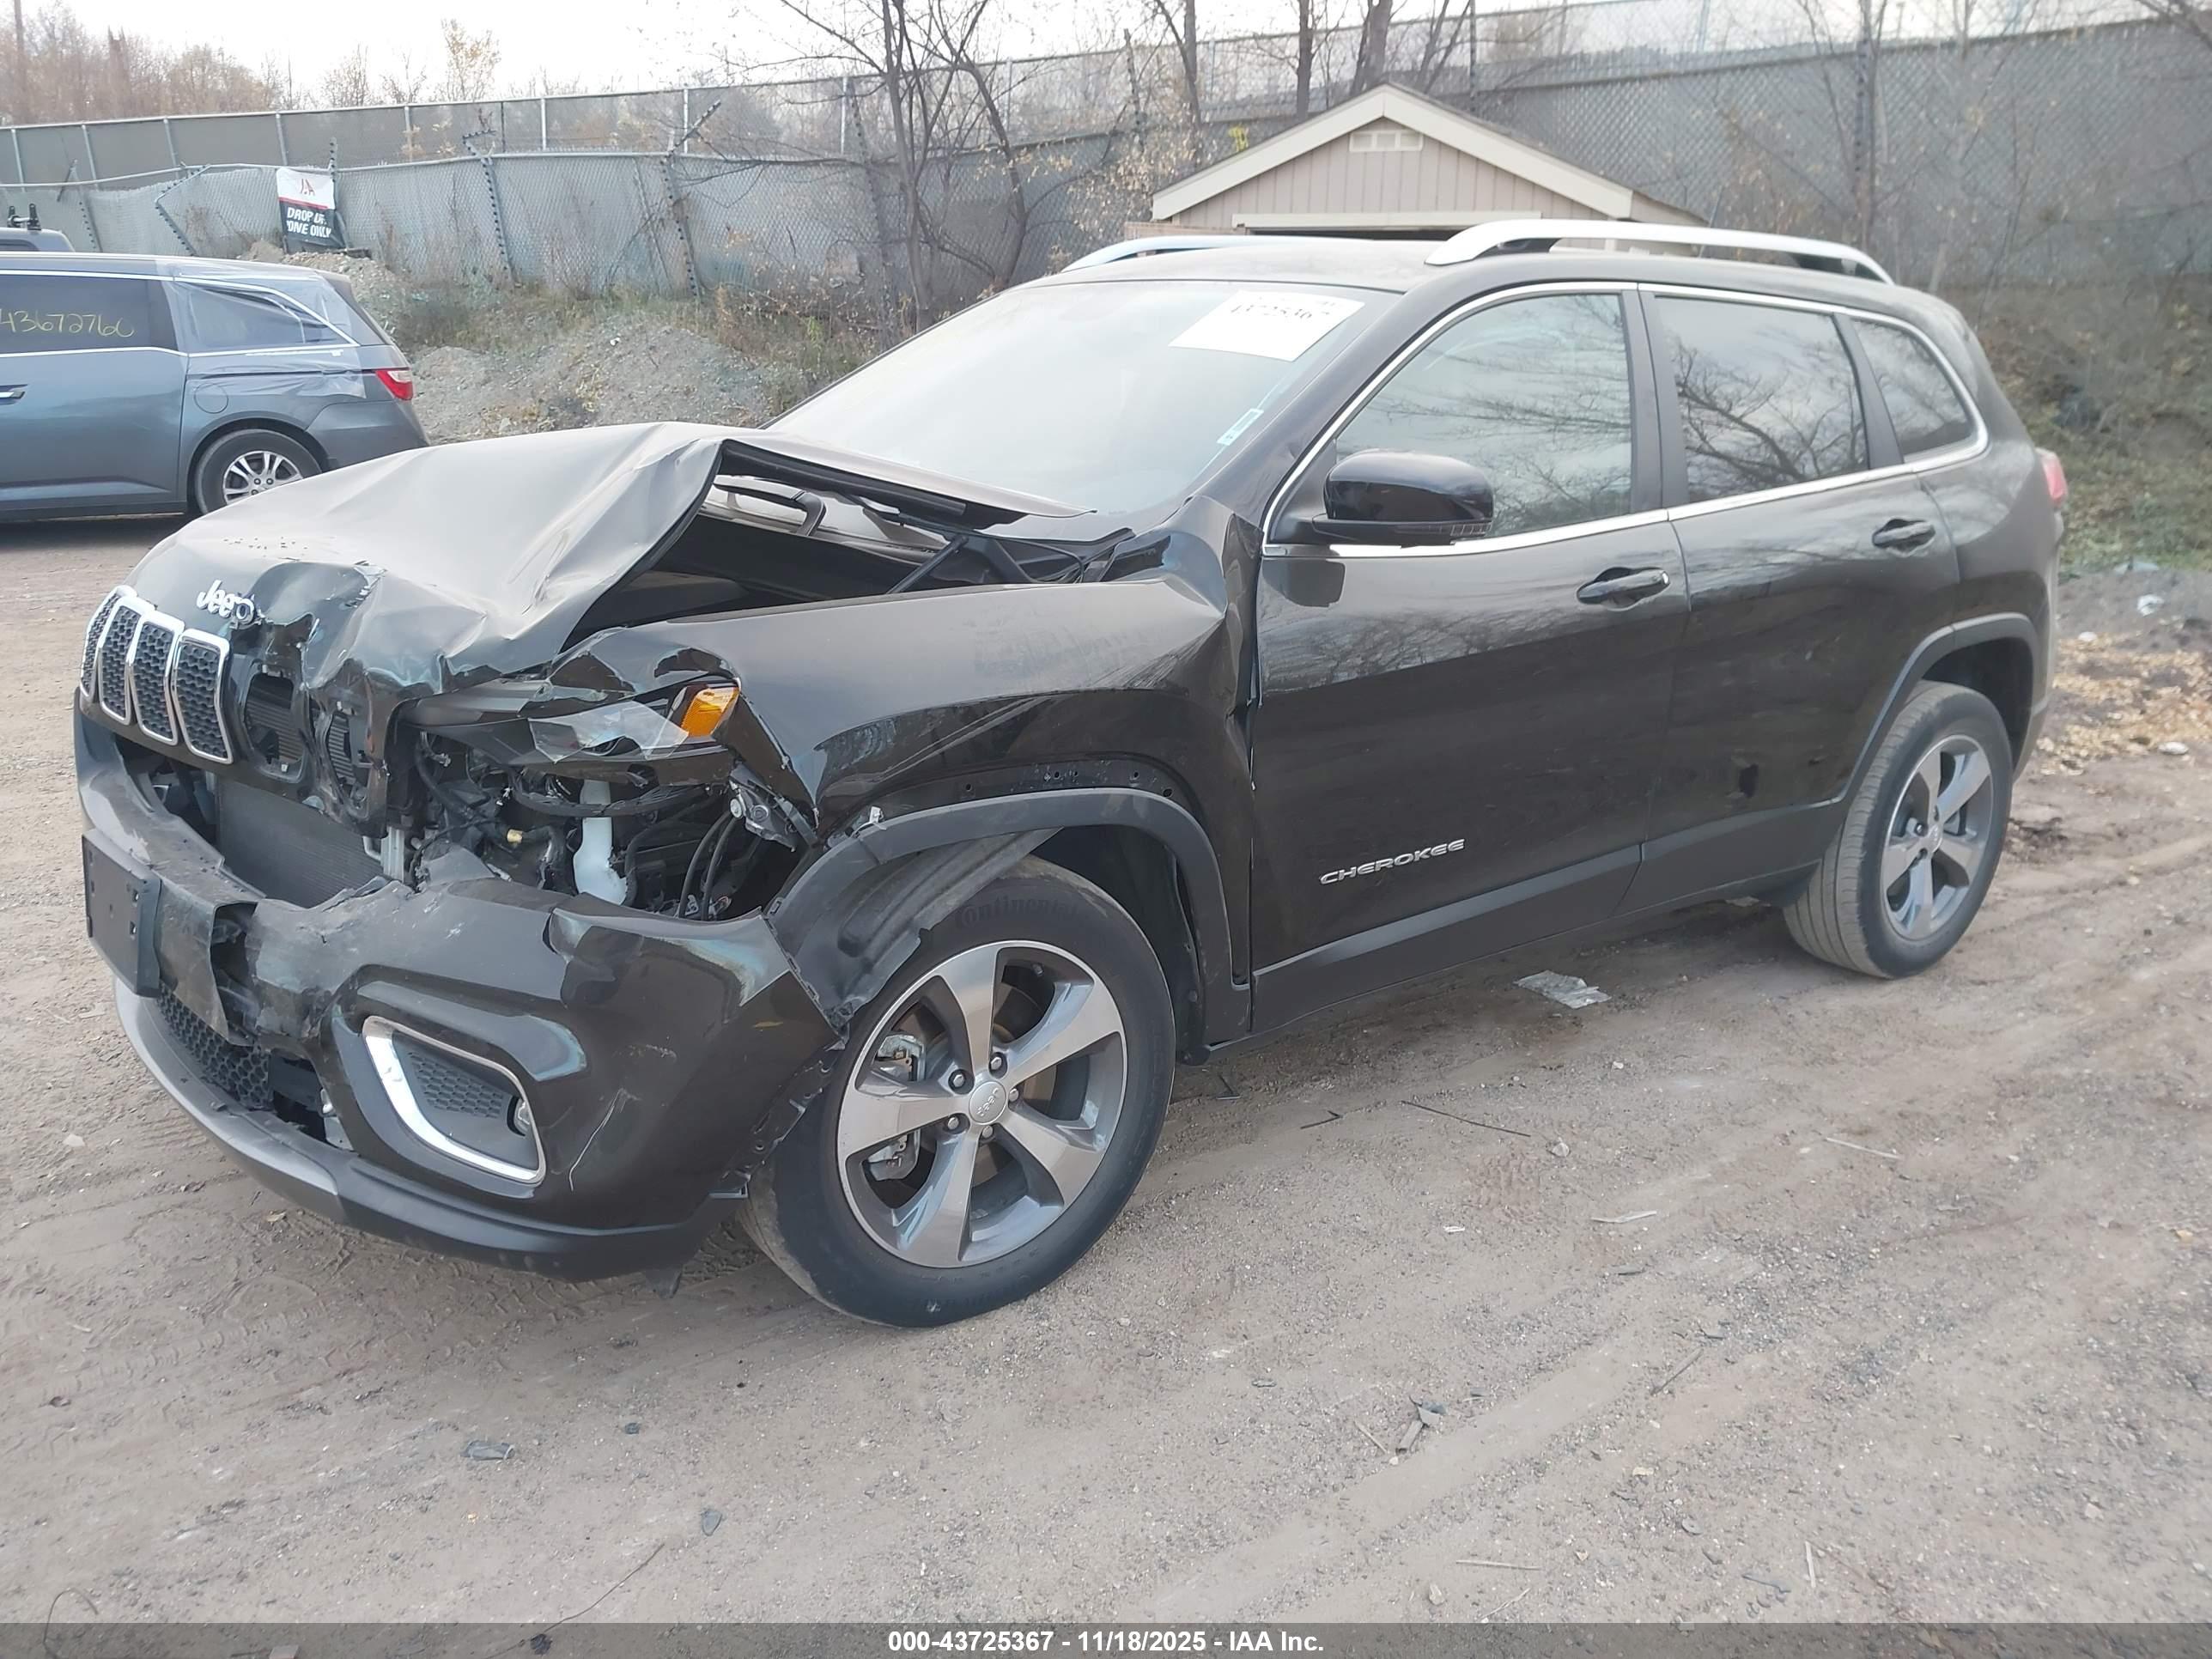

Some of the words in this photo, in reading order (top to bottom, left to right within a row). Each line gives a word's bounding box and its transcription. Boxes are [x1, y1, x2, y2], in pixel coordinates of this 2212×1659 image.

[287, 207, 314, 222] DROP
[196, 580, 255, 625] Jeep
[1320, 838, 1465, 885] CHEROKEE
